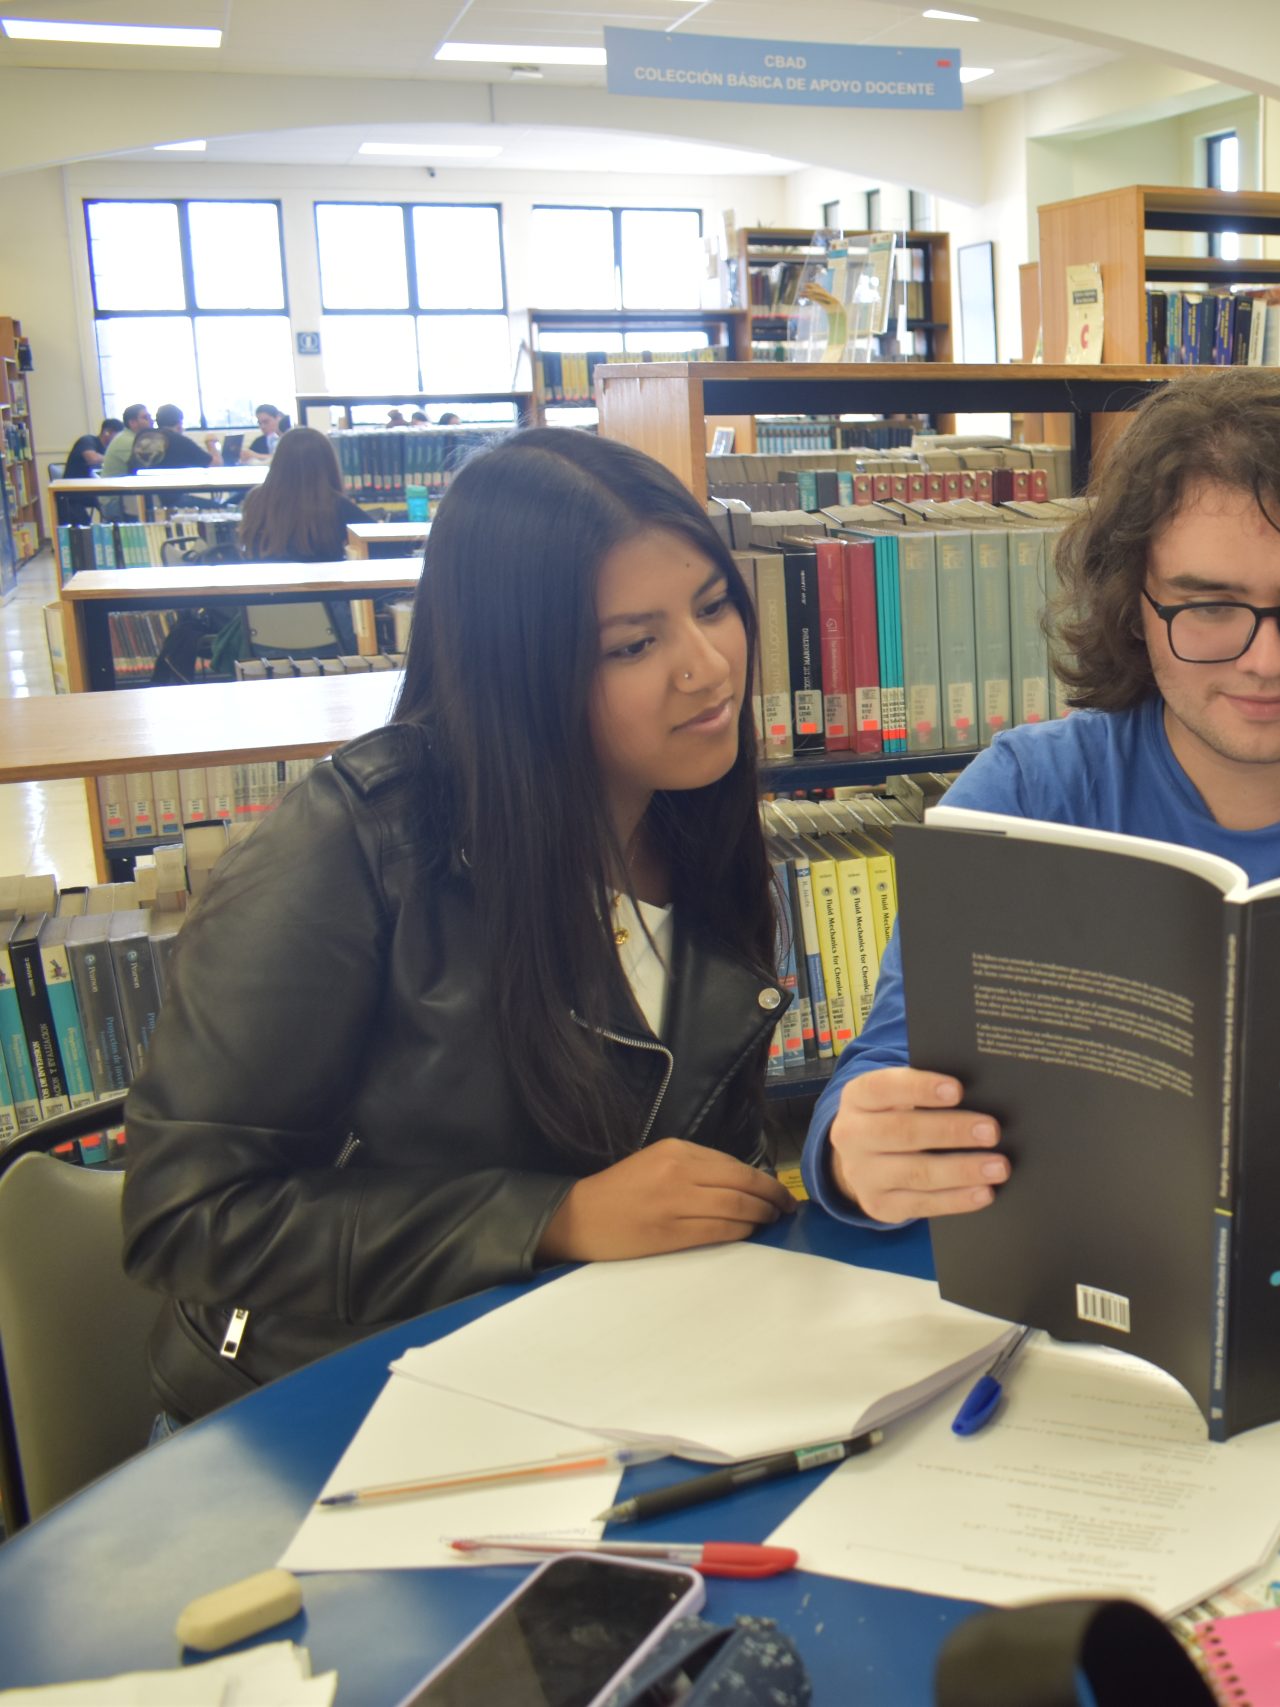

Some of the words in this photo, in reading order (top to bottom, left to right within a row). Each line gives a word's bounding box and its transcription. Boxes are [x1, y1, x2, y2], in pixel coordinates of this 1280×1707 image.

[764, 55, 806, 70] CBAD
[634, 66, 723, 86] COLECCIÓN
[727, 72, 782, 89] BÁSICA
[787, 78, 806, 91] DE
[810, 79, 861, 94] APOYO
[866, 81, 935, 96] DOCENTE
[802, 628, 811, 666] MARKETING
[825, 898, 833, 916] Fluid
[853, 898, 862, 914] Fluid
[880, 894, 889, 910] Fluid
[828, 918, 838, 953] Mechanics
[856, 916, 866, 952] Mechanics
[883, 912, 892, 944] Mechani
[88, 966, 98, 993] Pearson
[130, 962, 140, 989] Pearson
[863, 965, 871, 993] Chemic
[39, 1023, 56, 1068] EVALUACION
[105, 1016, 119, 1054] Proyectos
[113, 1055, 122, 1064] de
[32, 1041, 47, 1079] INVERSION
